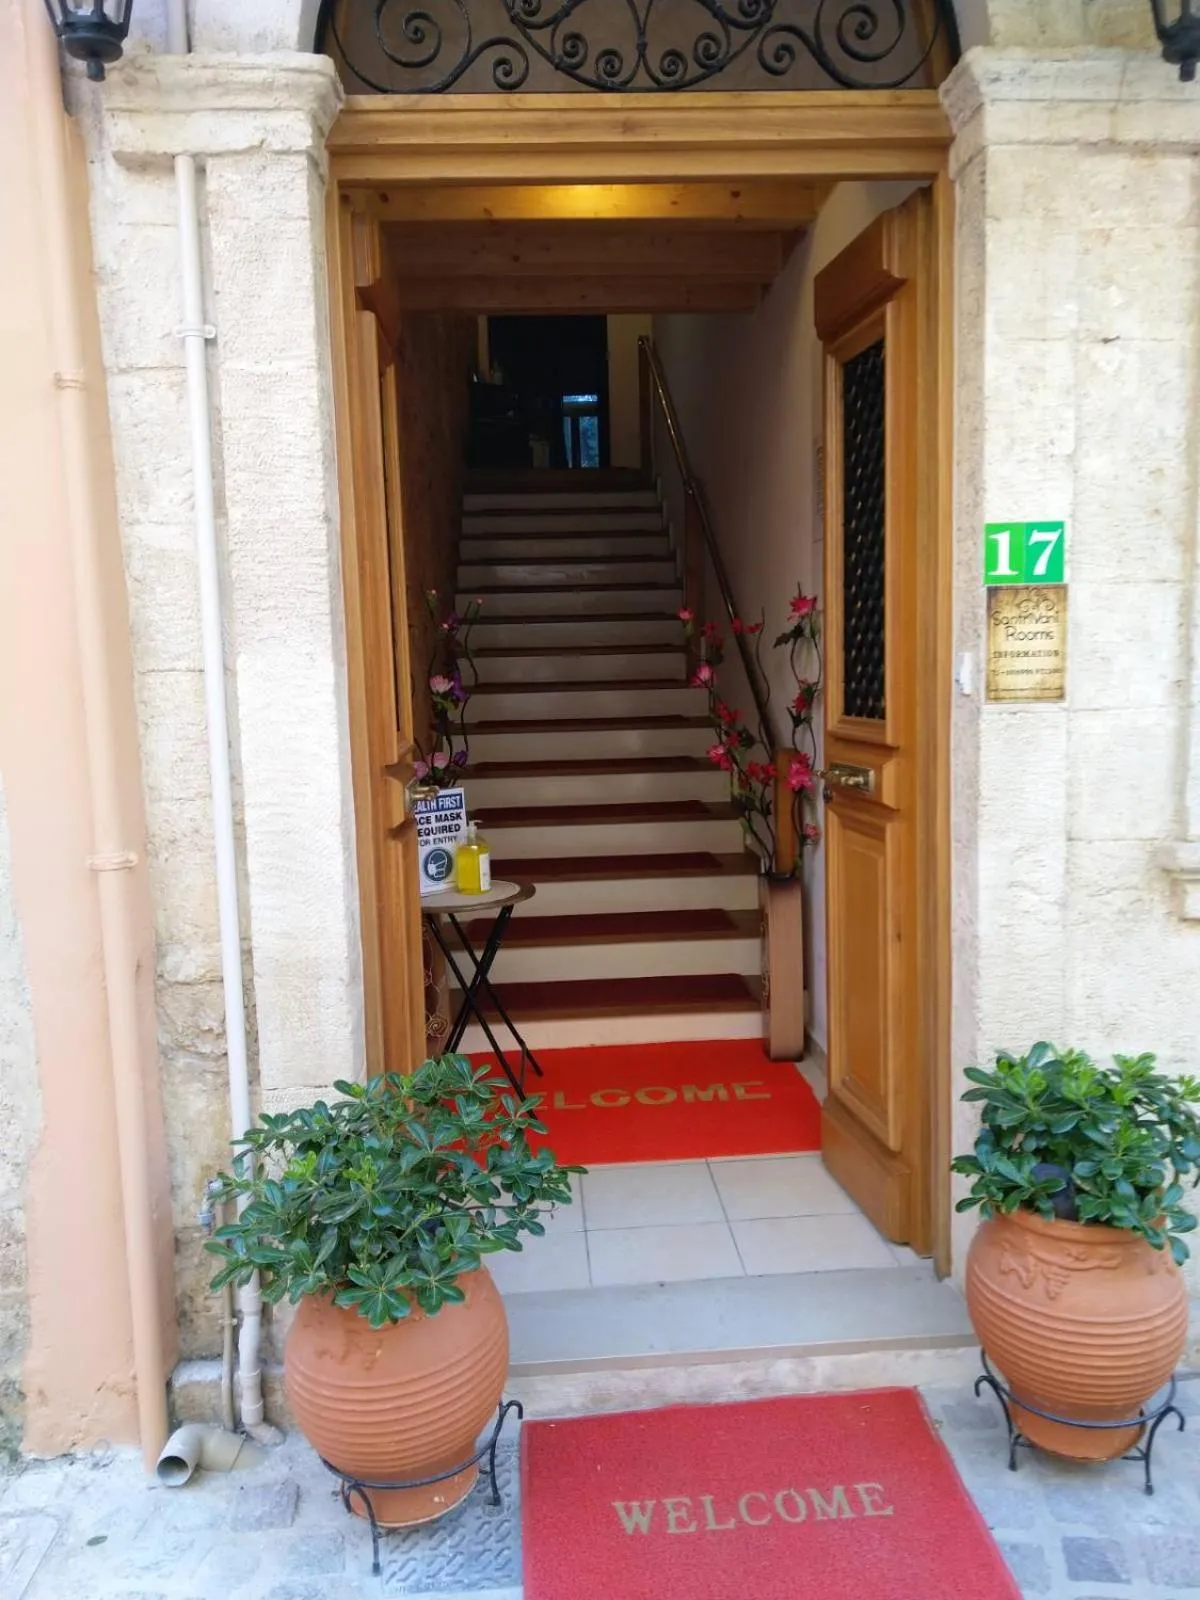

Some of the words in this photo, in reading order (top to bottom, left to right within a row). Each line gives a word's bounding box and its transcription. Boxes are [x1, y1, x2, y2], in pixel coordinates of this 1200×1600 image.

[987, 528, 1063, 576] 17
[1005, 625, 1056, 641] Rooms
[438, 795, 461, 809] FIRST
[416, 814, 432, 825] CE
[434, 811, 462, 823] MASK
[417, 823, 461, 837] EQUIRED
[419, 838, 431, 847] OR
[433, 835, 457, 845] ENTRY
[611, 1482, 895, 1536] WELCOME
